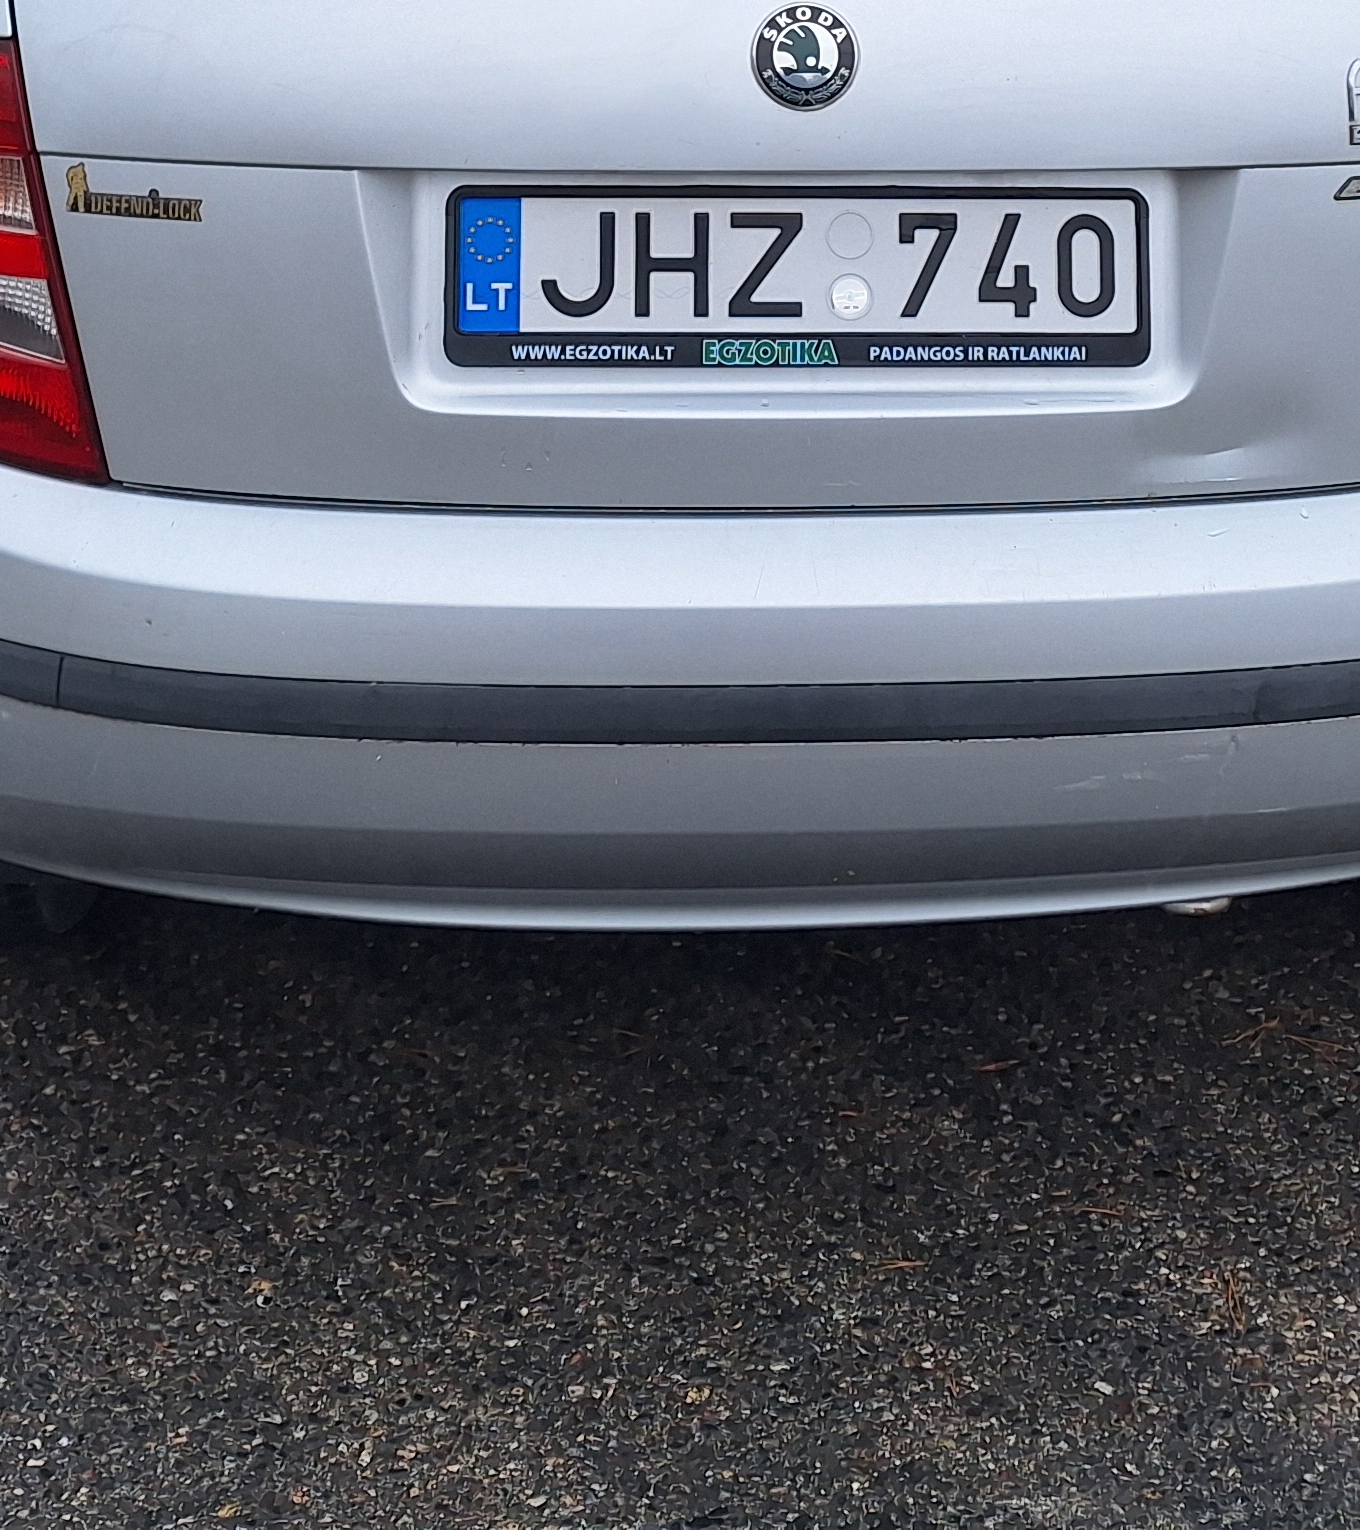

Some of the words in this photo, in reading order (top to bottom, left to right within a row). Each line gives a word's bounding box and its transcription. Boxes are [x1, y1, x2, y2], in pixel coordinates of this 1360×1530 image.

[90, 194, 203, 222] DEFEND-LOCK
[541, 211, 803, 318] JHZ
[898, 212, 1116, 318] 740
[465, 282, 513, 311] LT
[511, 344, 675, 361] WWW.EGZOTIKA.LT
[701, 338, 839, 365] EGZOTIKA
[869, 346, 964, 361] PADANGOS
[967, 346, 984, 361] IR
[987, 346, 1087, 361] RATLANKIAI
